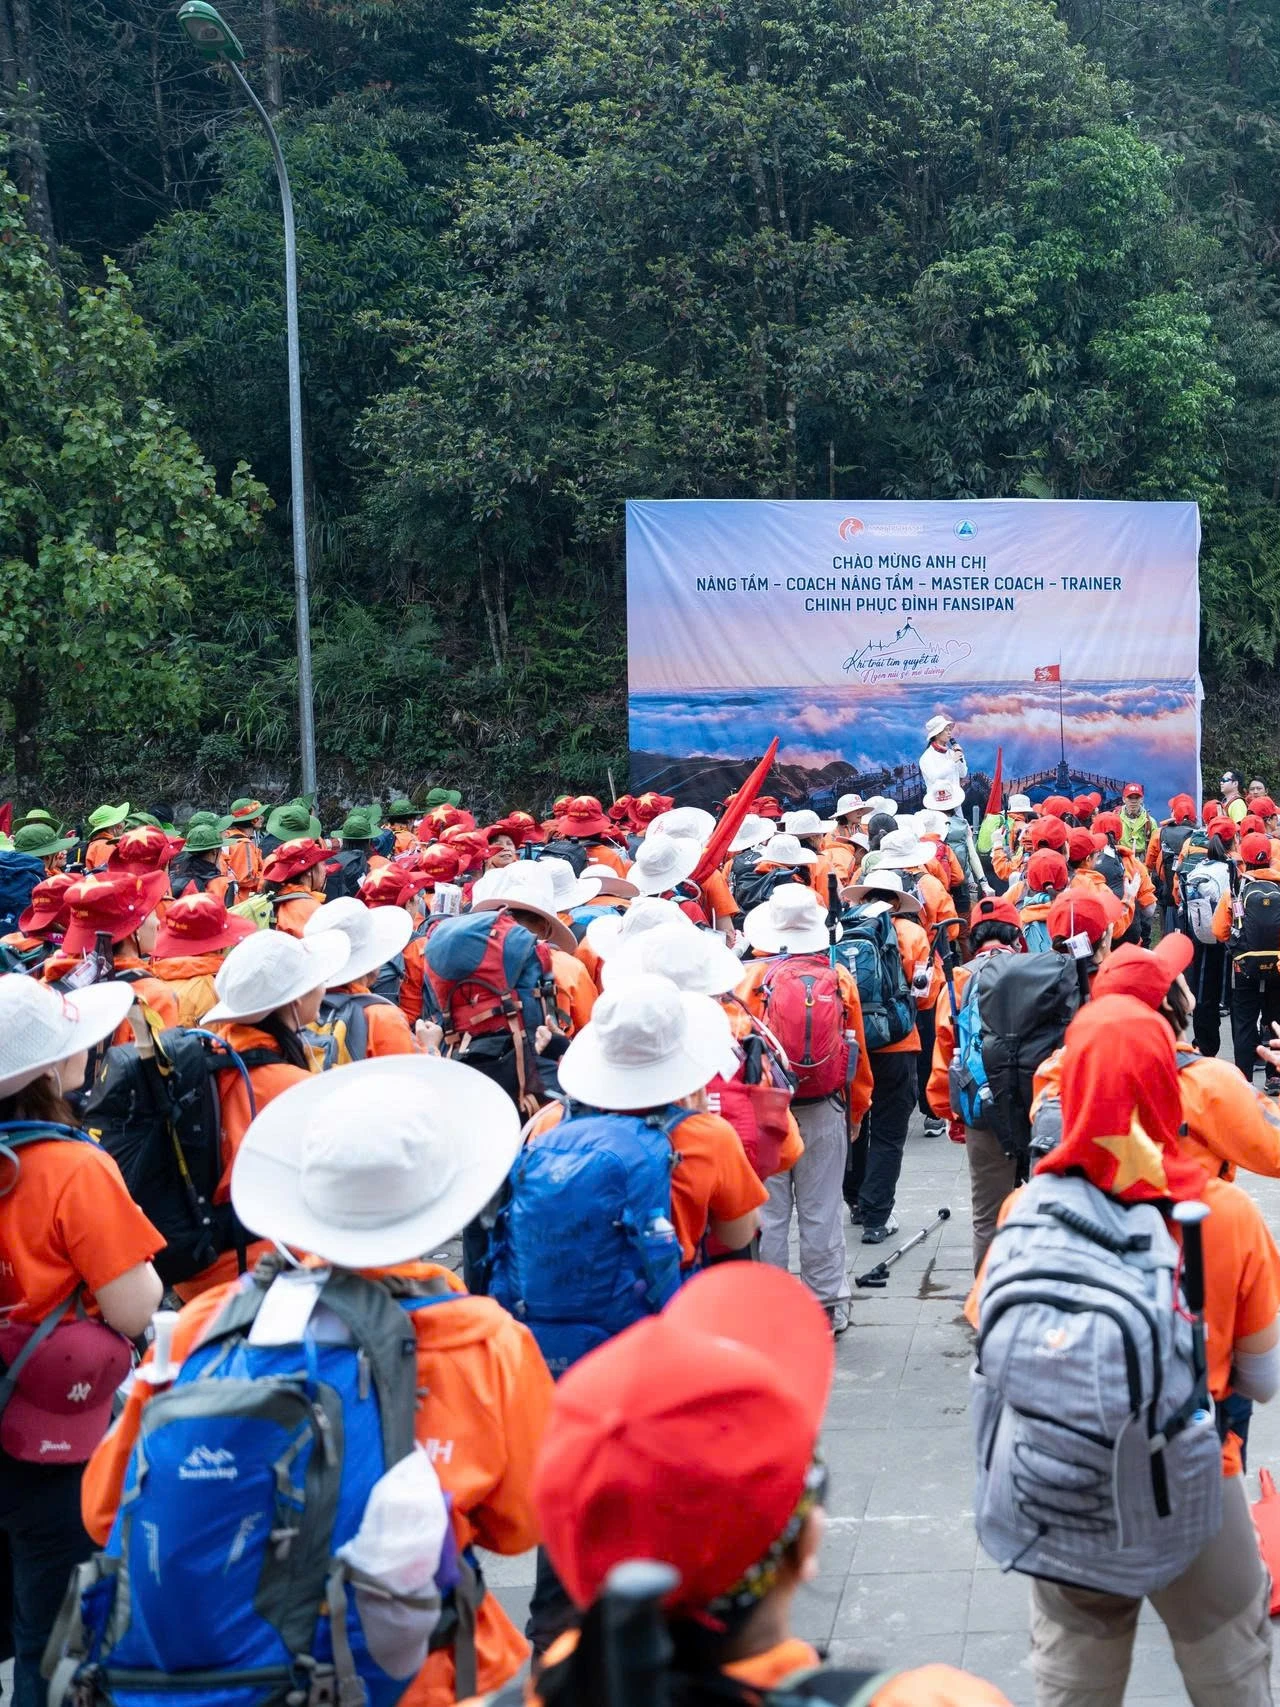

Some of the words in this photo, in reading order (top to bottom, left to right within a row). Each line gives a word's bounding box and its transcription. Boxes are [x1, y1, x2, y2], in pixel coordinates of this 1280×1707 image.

[833, 552, 874, 570] CHÀO
[878, 551, 922, 570] MỪNG
[925, 555, 957, 570] ANH
[961, 555, 987, 572] CHỊ
[696, 575, 737, 592] NÂNG
[786, 576, 837, 591] COACH
[841, 574, 882, 591] NÂNG
[931, 576, 990, 591] MASTER
[994, 576, 1044, 591] COACH
[1061, 576, 1122, 591] TRAINER
[805, 597, 851, 612] CHINH
[856, 597, 898, 614] PHỤC
[942, 597, 1015, 611] FANSIPAN
